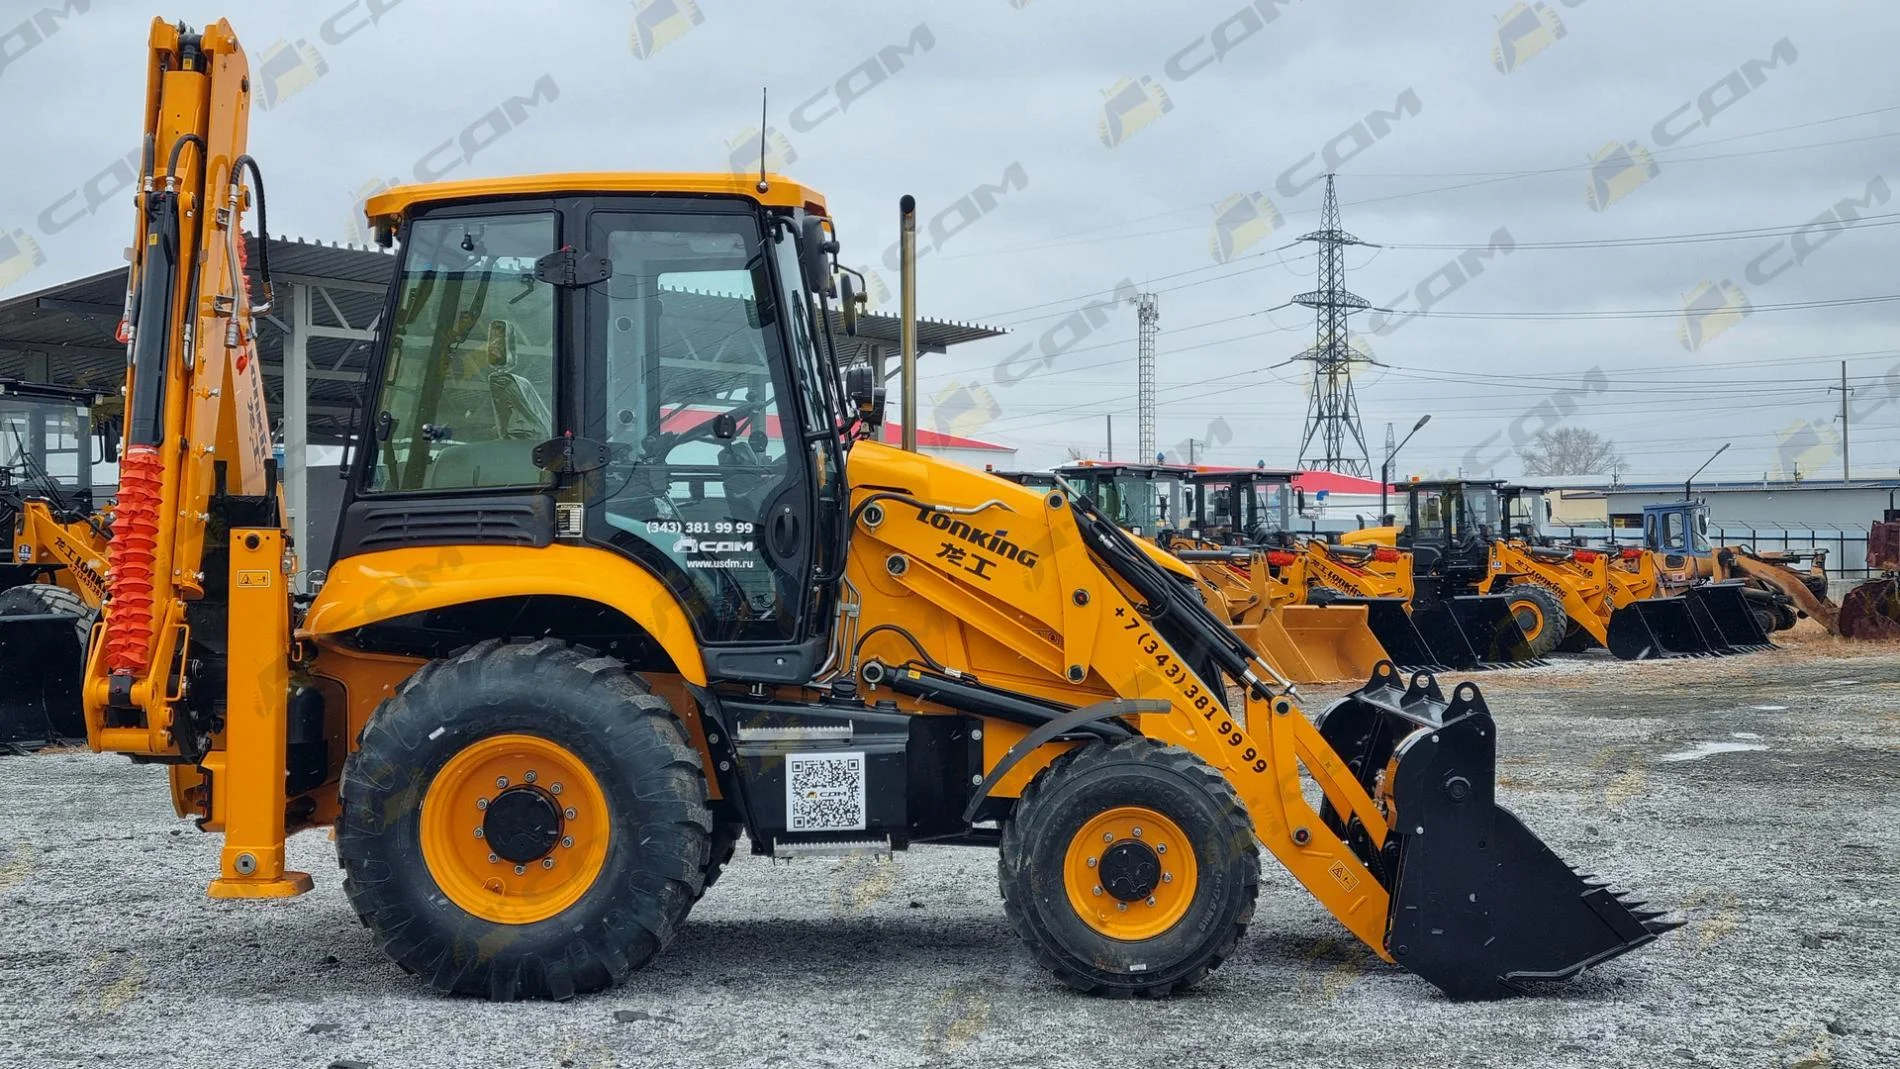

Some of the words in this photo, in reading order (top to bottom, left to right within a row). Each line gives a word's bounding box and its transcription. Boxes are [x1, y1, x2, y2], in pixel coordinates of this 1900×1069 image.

[646, 521, 682, 534] (343)
[685, 522, 710, 534] 381
[714, 522, 733, 534] 99
[735, 522, 754, 534] 99
[686, 559, 754, 569] www.usdm.ru
[935, 542, 998, 581] 龙工
[1217, 721, 1243, 747] 99
[1241, 747, 1268, 773] 99
